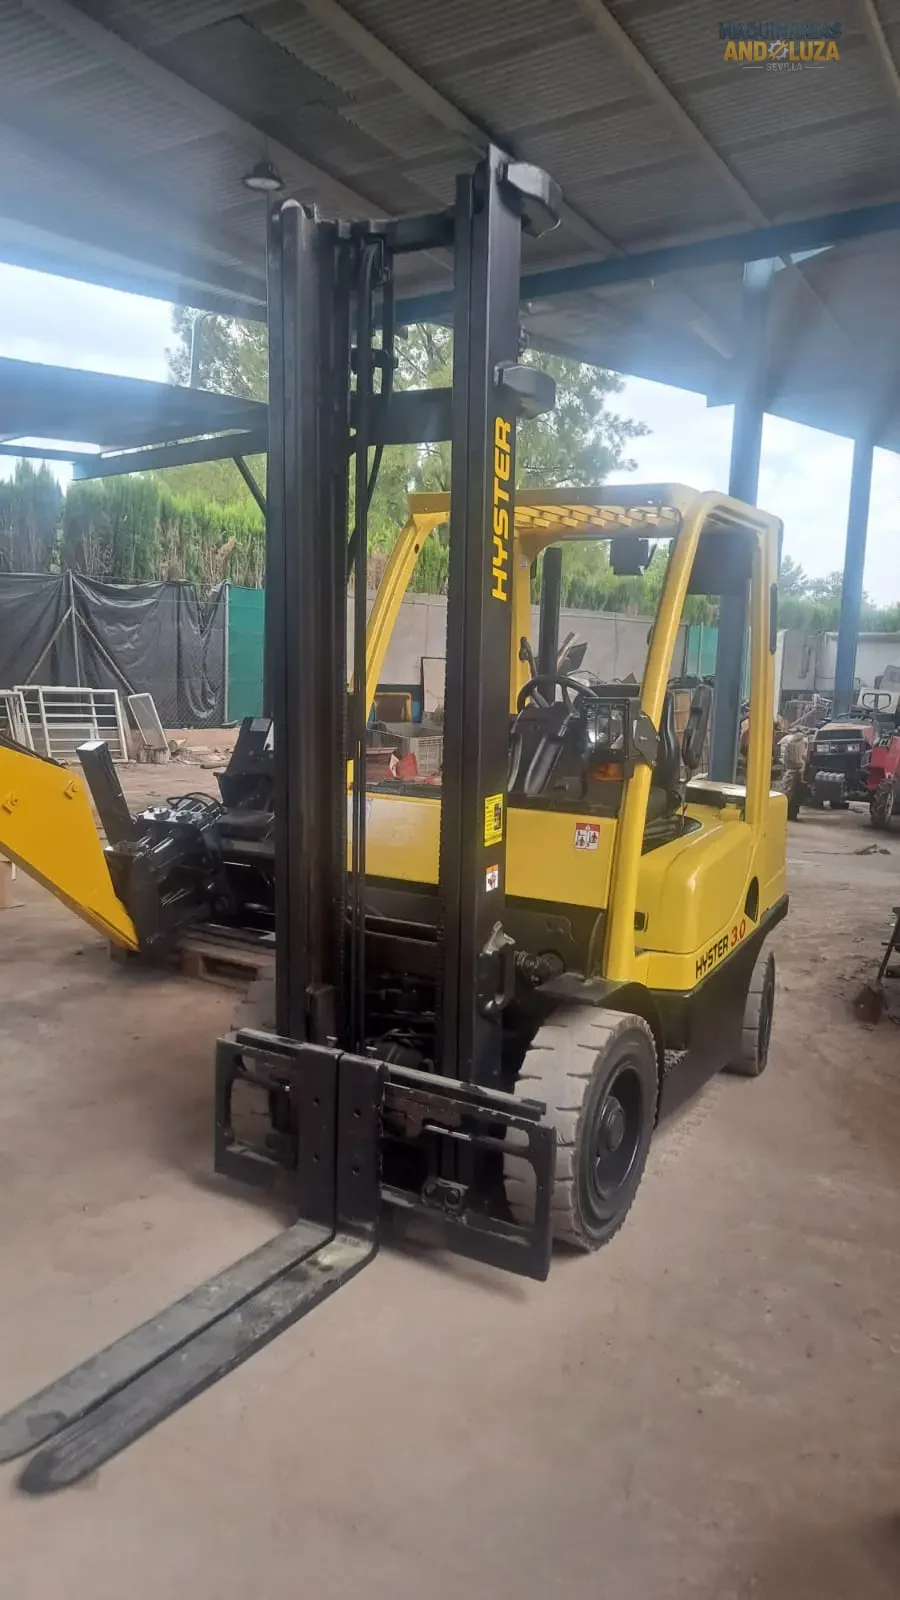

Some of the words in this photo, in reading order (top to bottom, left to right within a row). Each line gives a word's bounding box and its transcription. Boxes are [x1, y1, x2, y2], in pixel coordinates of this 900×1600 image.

[491, 416, 512, 601] HYSTER
[695, 934, 729, 980] HYSTER
[730, 918, 746, 948] 3.0
